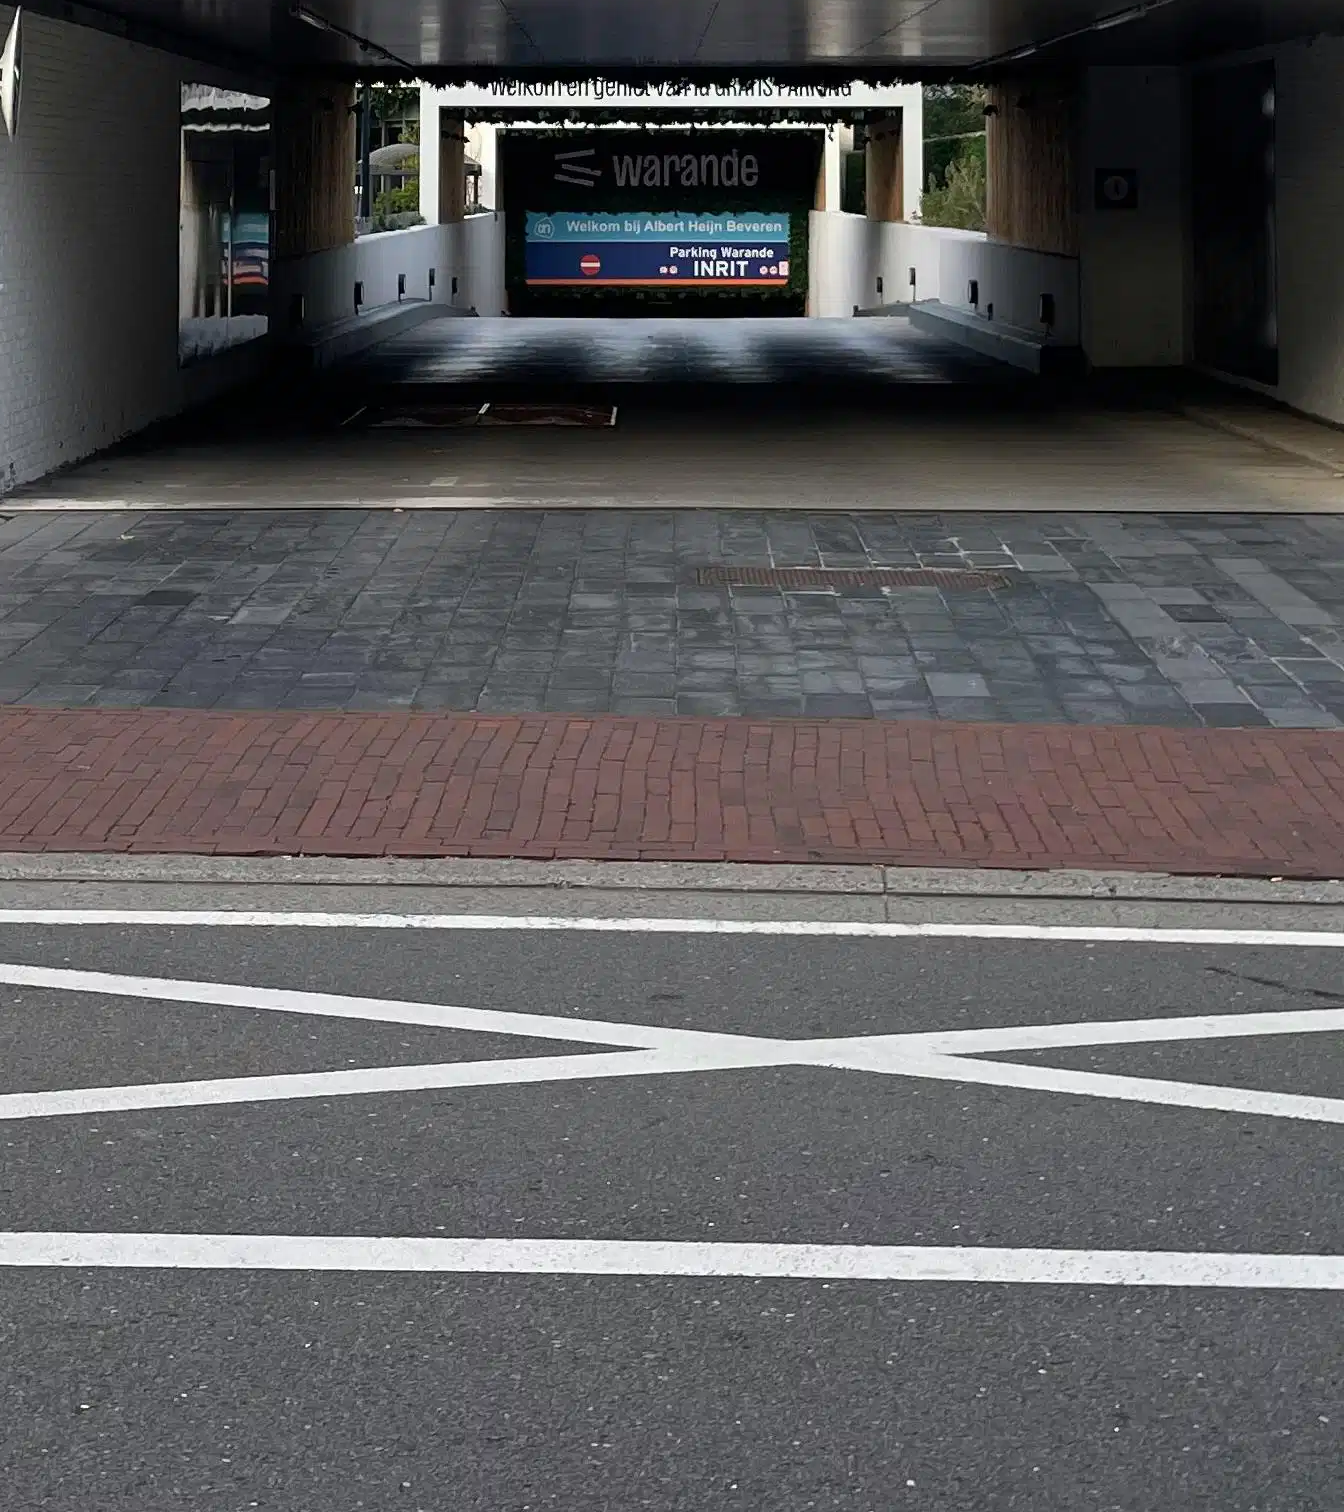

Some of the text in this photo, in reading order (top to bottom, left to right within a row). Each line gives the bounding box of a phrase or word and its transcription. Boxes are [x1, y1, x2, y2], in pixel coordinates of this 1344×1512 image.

[612, 148, 759, 188] warande
[567, 220, 782, 234] Welkom bij Albert Heijn Beveren
[670, 247, 774, 259] Parking Warande
[694, 261, 749, 277] INRIT
